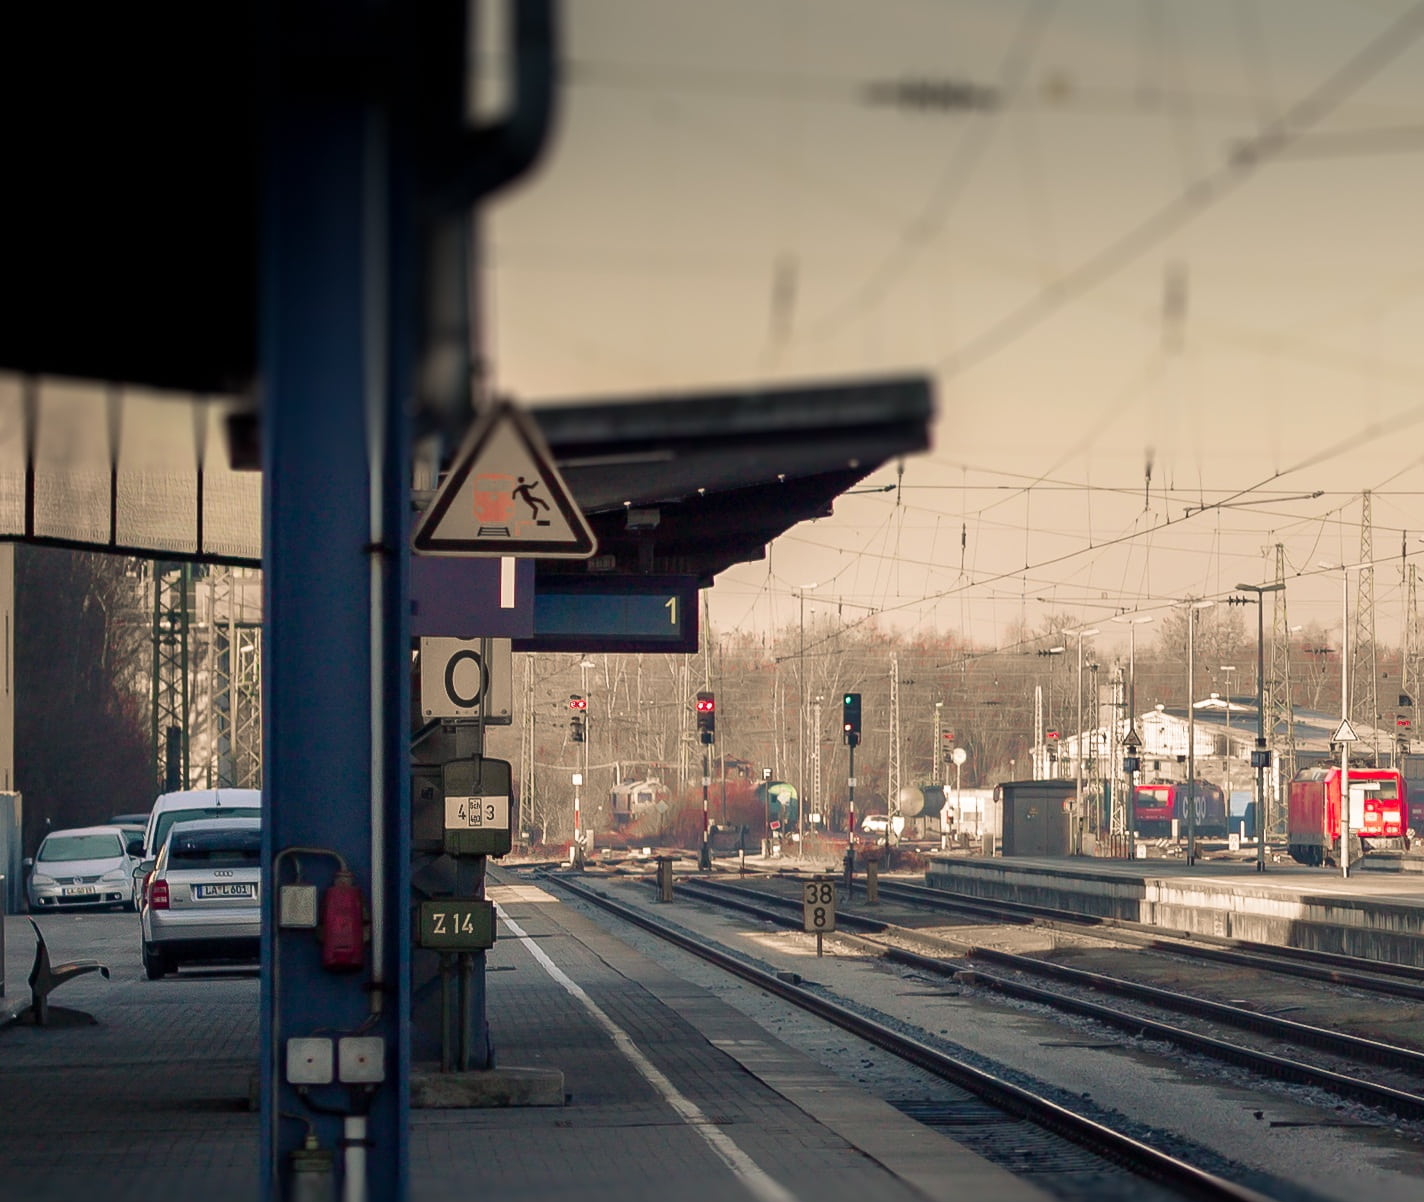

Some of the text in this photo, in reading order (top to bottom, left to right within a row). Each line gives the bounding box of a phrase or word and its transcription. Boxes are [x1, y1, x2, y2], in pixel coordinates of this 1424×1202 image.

[664, 596, 676, 625] 1
[457, 804, 467, 821] 4
[486, 805, 495, 821] 3
[806, 884, 832, 904] 38
[433, 913, 474, 934] Z 14
[814, 907, 826, 927] 8
